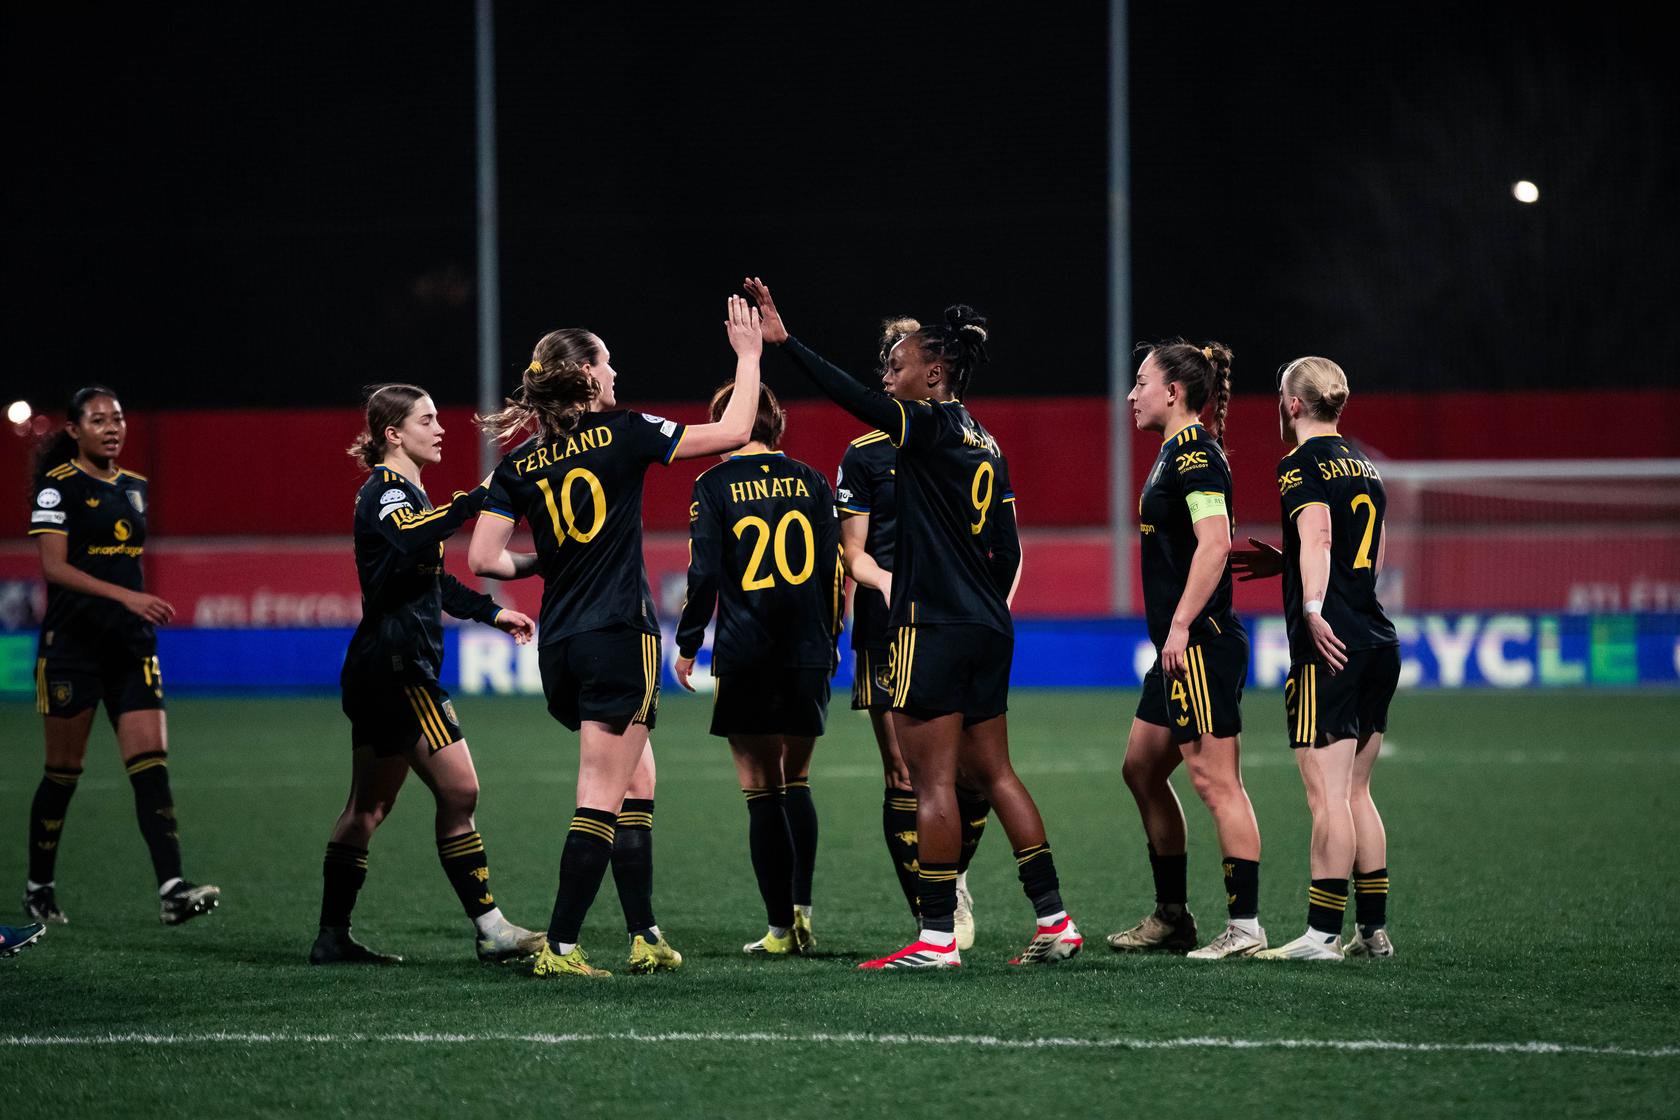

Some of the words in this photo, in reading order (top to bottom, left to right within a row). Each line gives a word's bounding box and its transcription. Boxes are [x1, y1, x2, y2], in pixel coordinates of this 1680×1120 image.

[514, 426, 613, 477] TERLAND
[535, 467, 607, 548] 10
[729, 477, 810, 504] HINATA
[971, 461, 994, 535] 9
[732, 509, 815, 592] 20
[1351, 493, 1377, 570] 2
[1171, 679, 1188, 712] 4
[1285, 677, 1296, 716] 2
